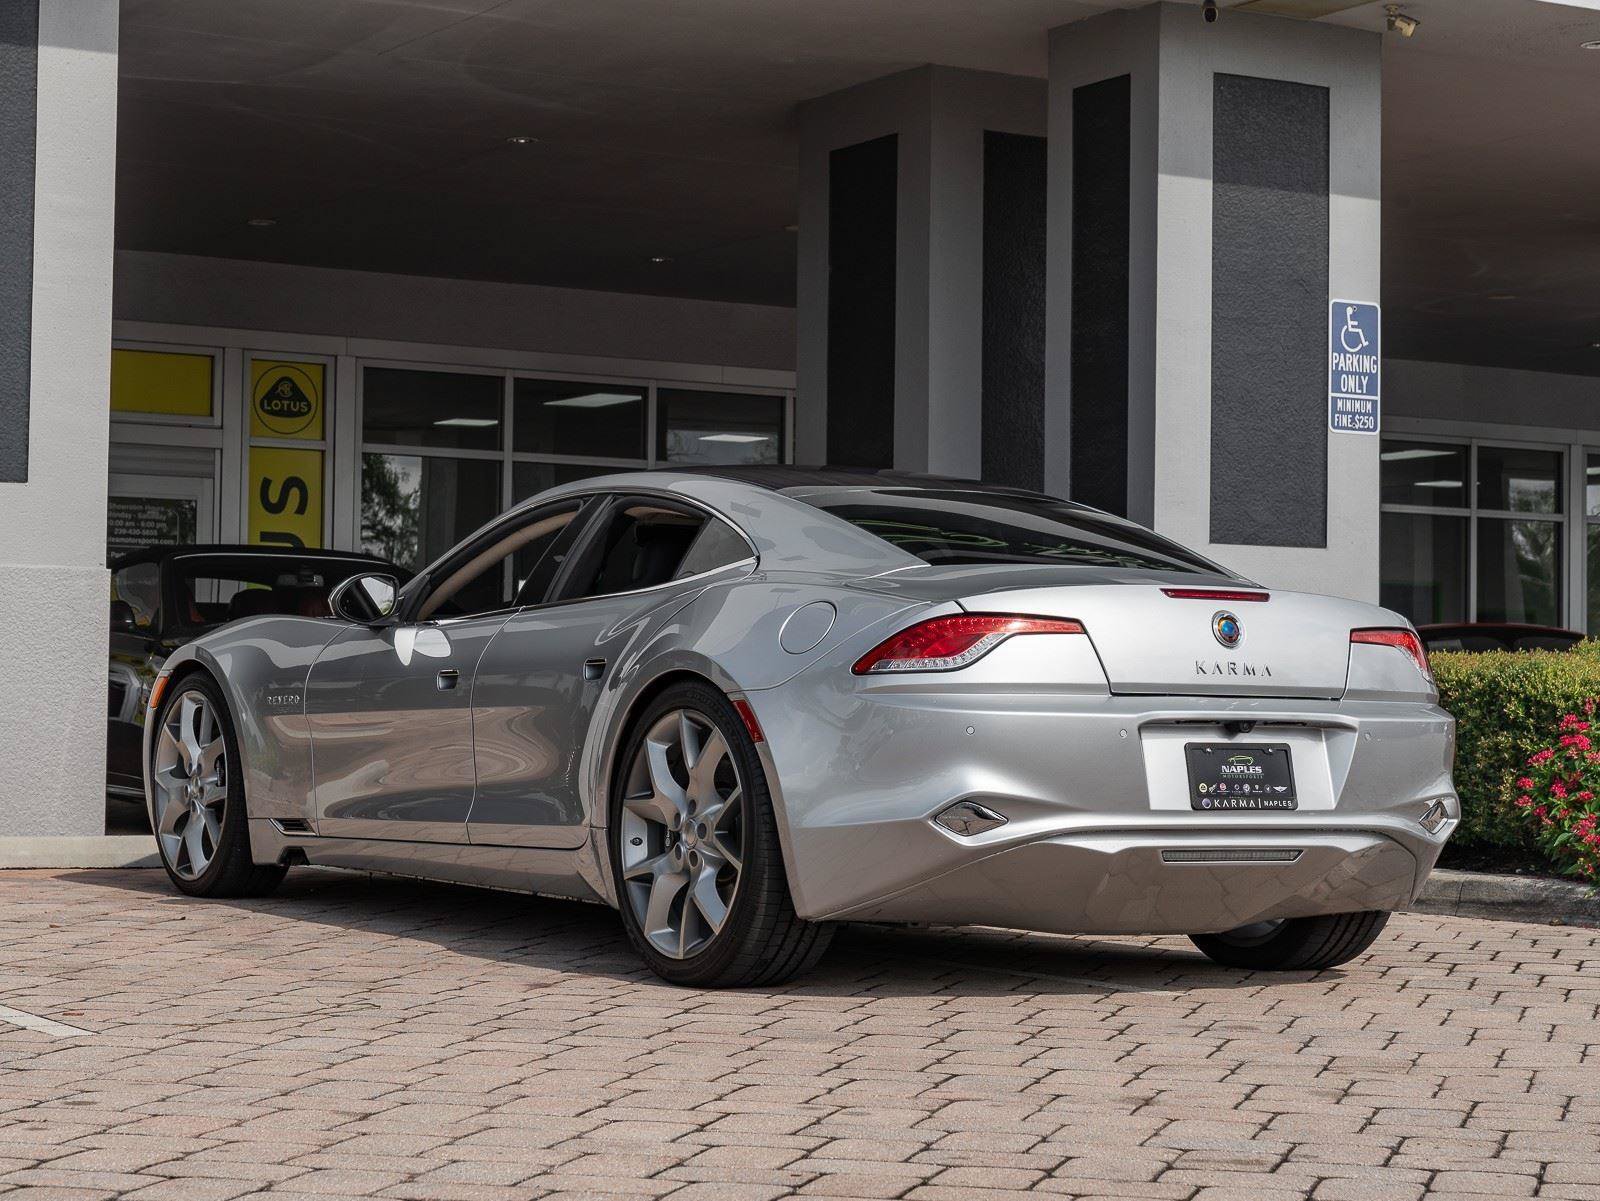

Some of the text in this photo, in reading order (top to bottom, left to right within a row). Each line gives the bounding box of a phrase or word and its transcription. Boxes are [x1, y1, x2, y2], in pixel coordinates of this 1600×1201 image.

[1332, 352, 1377, 373] PARKING
[1340, 374, 1369, 393] ONLY
[263, 400, 309, 412] LOTUS
[1337, 399, 1372, 413] MINIMUM
[1334, 413, 1375, 429] FINE $250
[1195, 660, 1272, 677] KARMA
[267, 695, 300, 704] REVERO
[1221, 765, 1263, 774] NAPLES
[1214, 799, 1256, 808] KARMA
